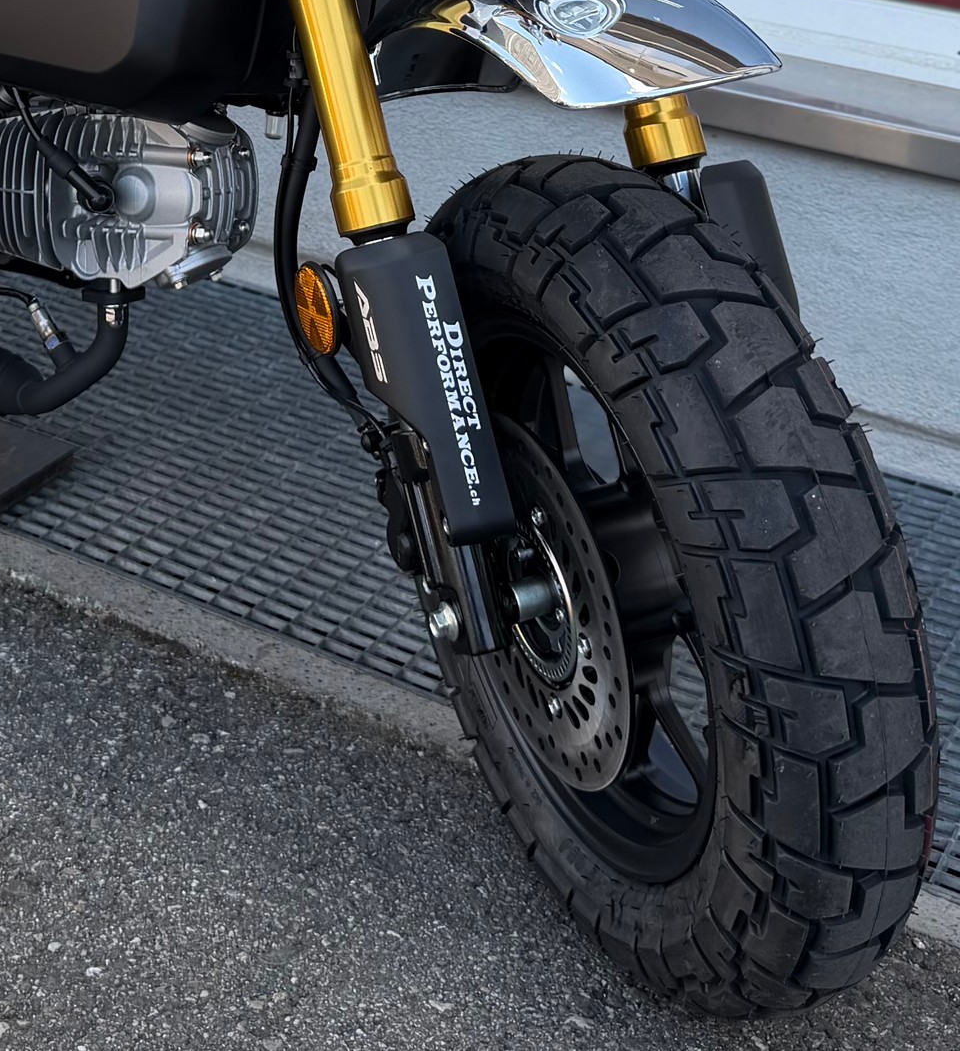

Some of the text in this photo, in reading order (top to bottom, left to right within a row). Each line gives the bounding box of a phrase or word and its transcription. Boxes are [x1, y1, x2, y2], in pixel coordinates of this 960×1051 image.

[352, 276, 389, 384] ABS
[442, 320, 482, 431] DIRECT
[415, 274, 482, 507] PERFORMANCE.ch
